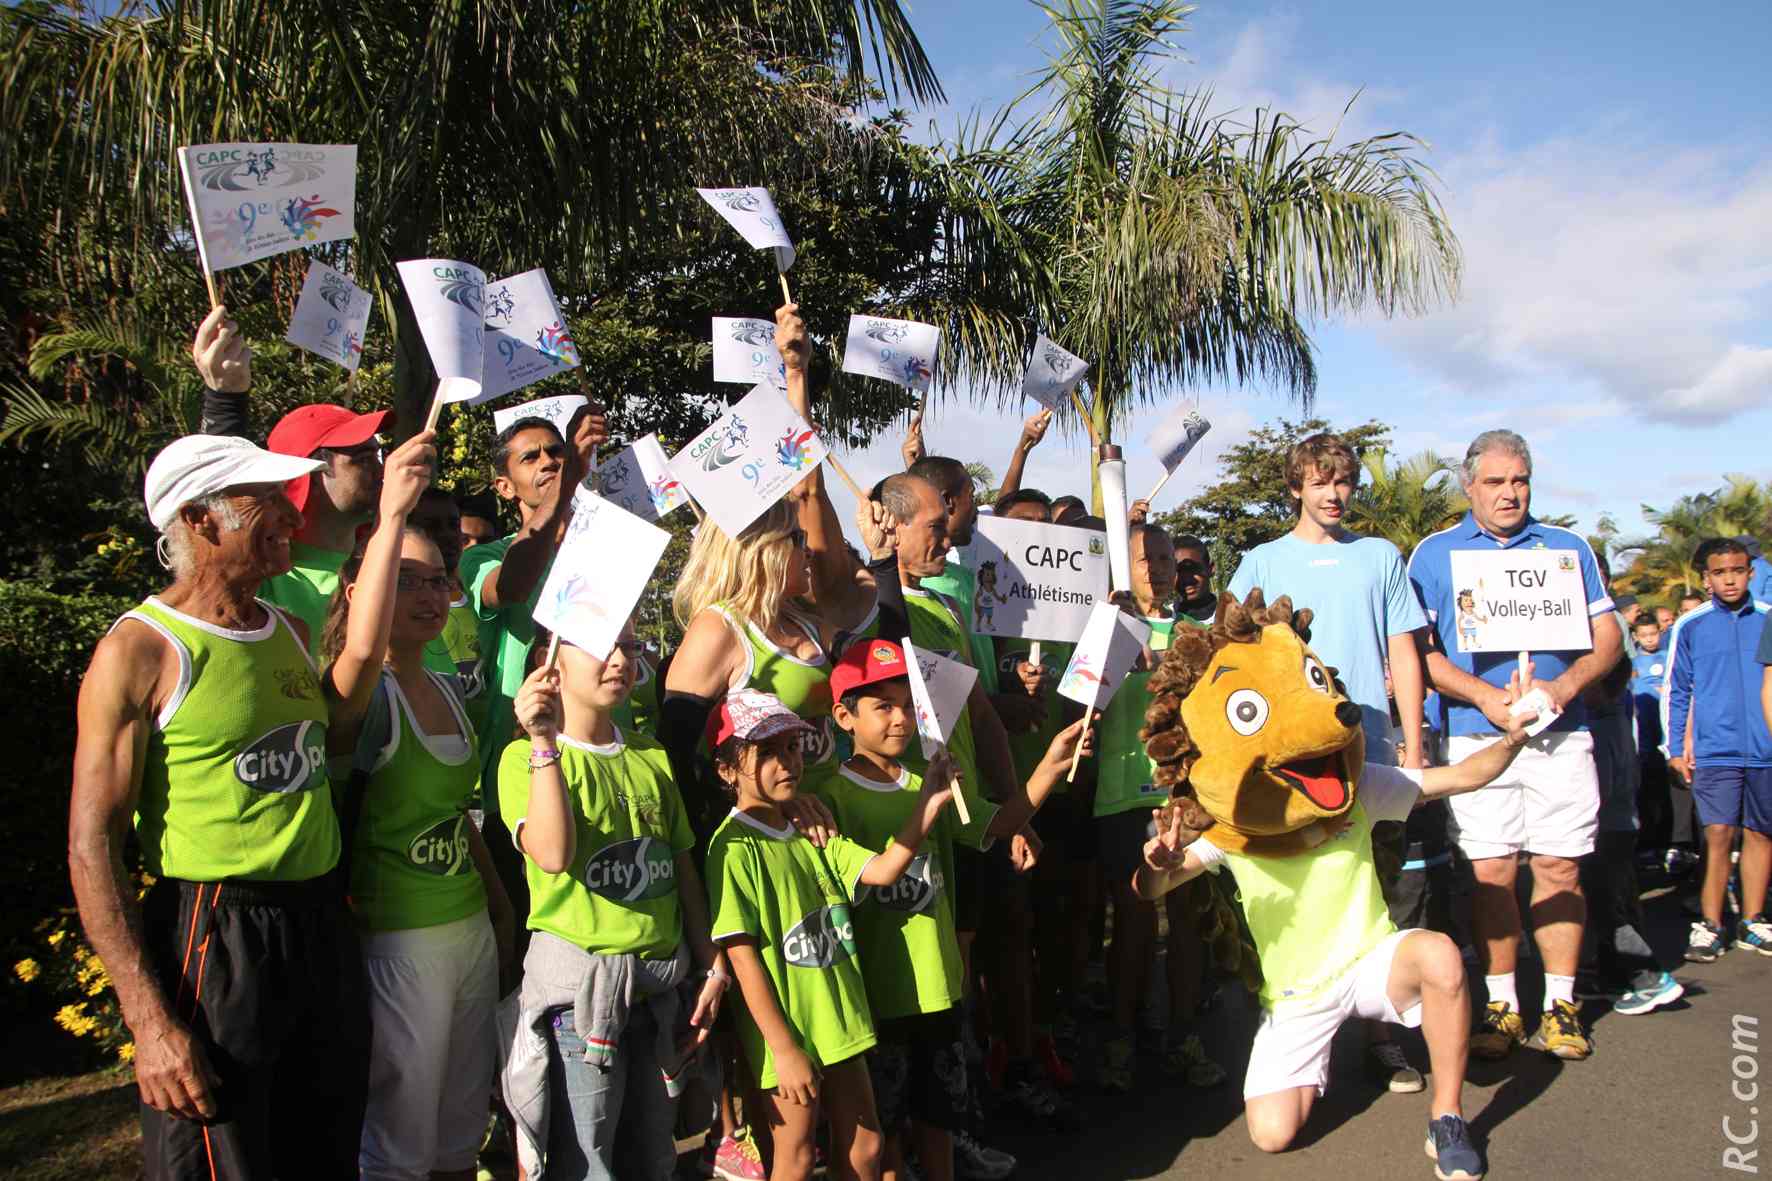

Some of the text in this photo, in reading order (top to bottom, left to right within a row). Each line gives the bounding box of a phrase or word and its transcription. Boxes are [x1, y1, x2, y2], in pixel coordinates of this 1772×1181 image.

[196, 150, 242, 166] CAPC
[433, 266, 471, 282] CAPC
[731, 321, 757, 330] CAPC
[690, 430, 721, 459] CAPC
[1025, 544, 1084, 572] CAPC
[1505, 569, 1547, 588] TGV
[1009, 581, 1093, 606] Athlétisme
[1486, 598, 1572, 622] Volley-Ball
